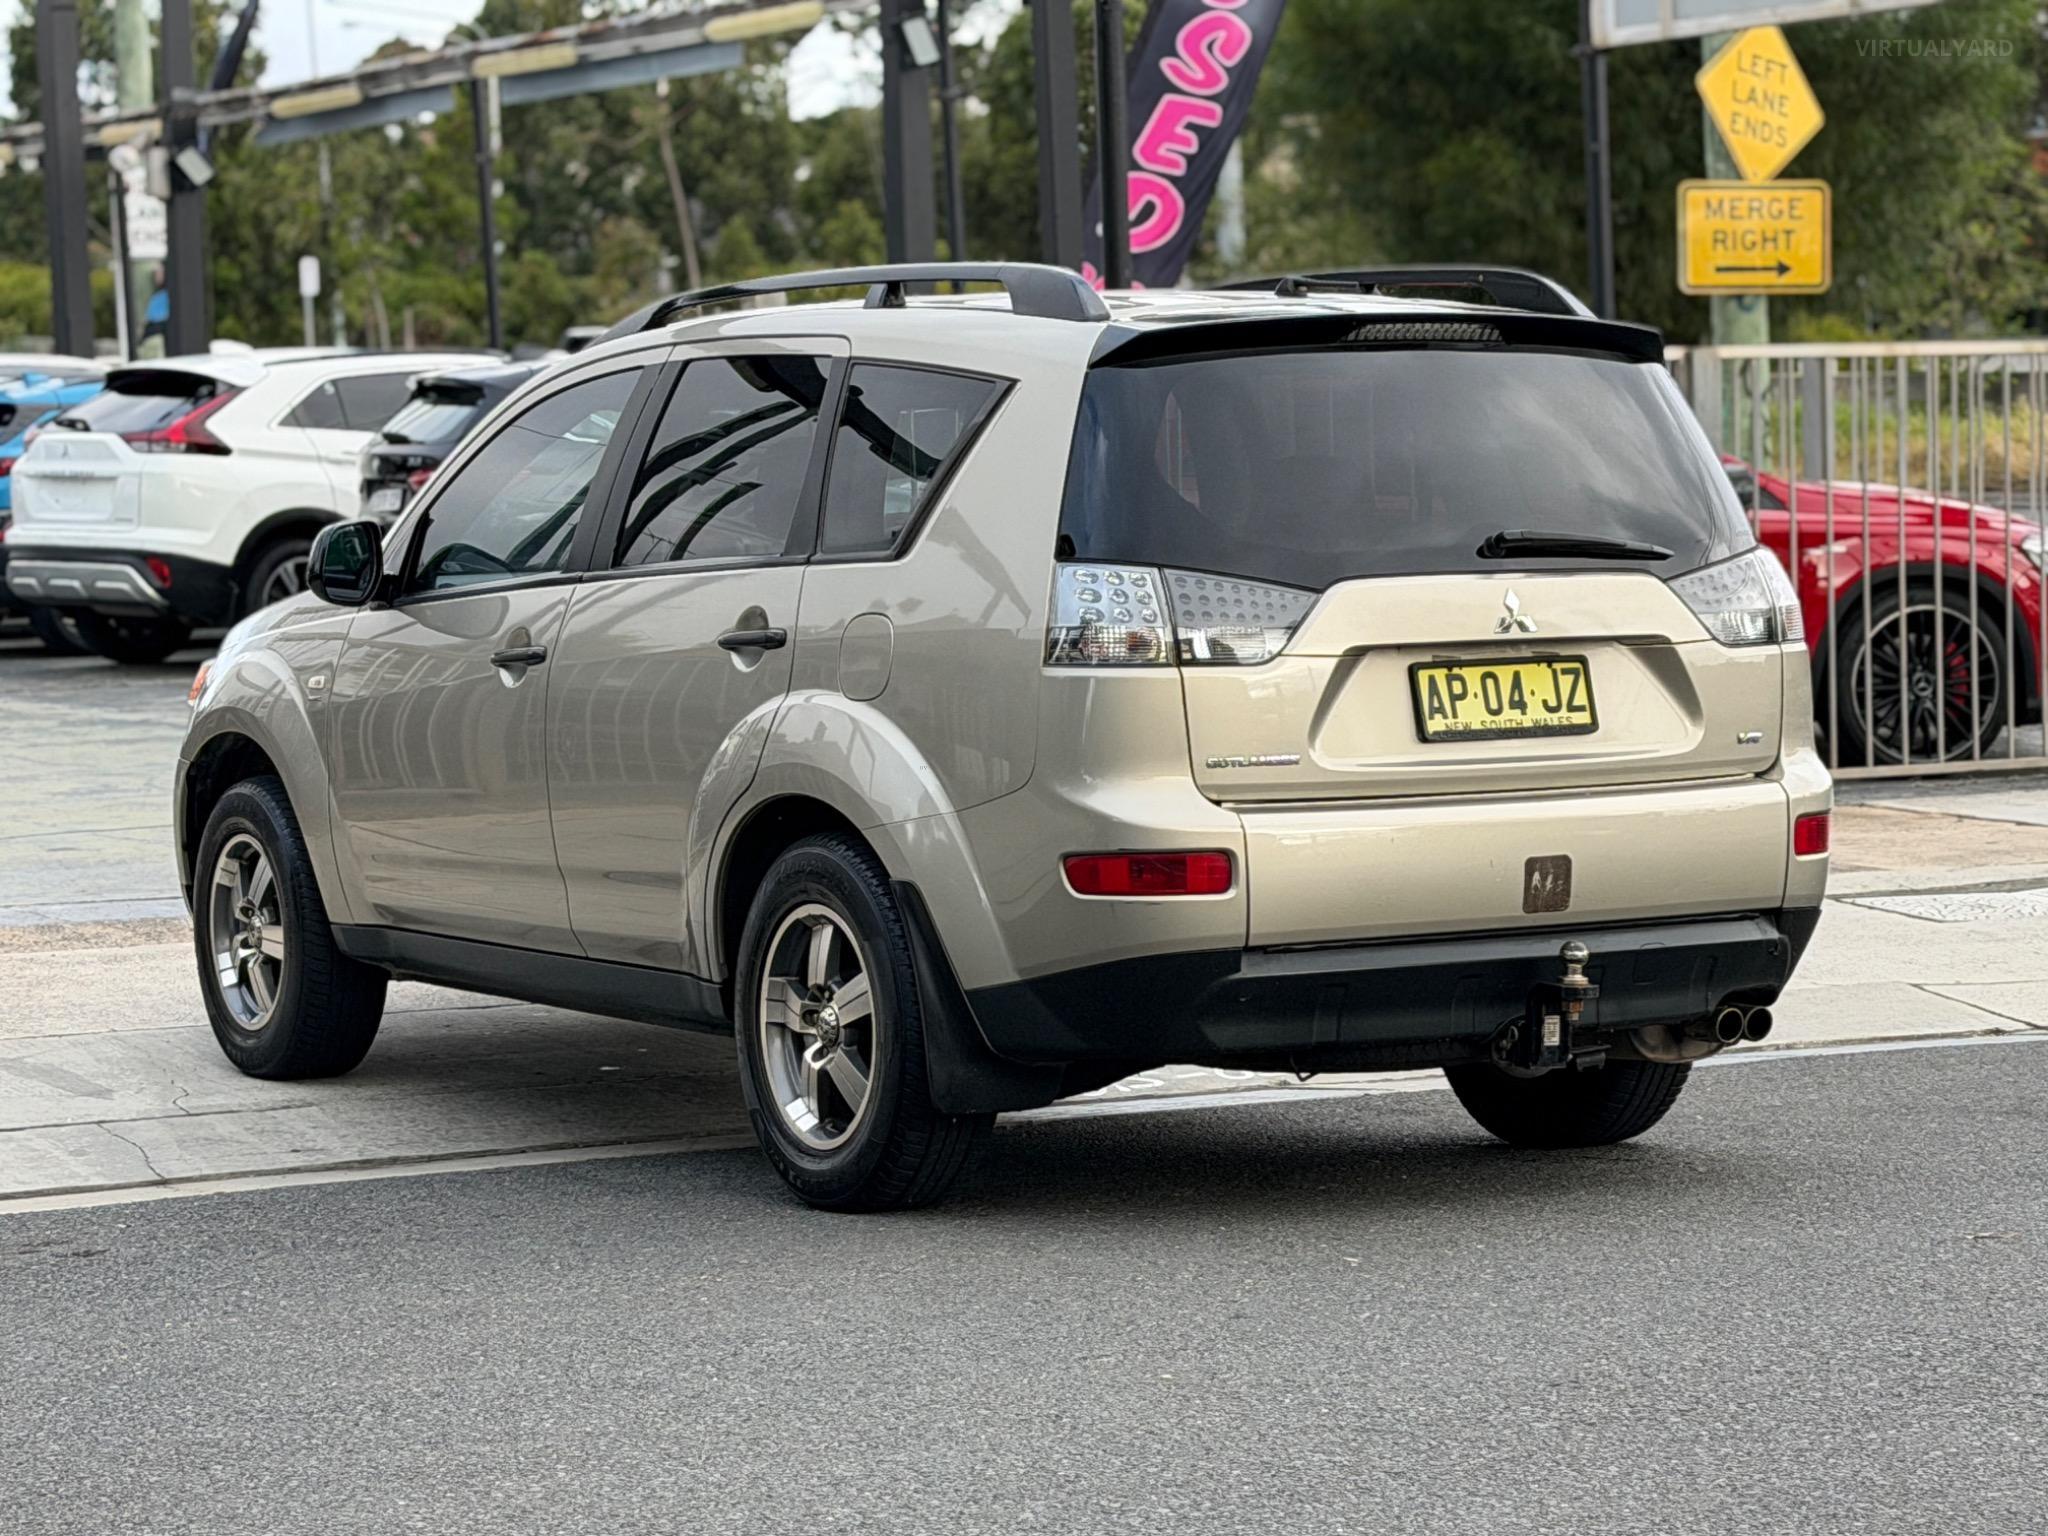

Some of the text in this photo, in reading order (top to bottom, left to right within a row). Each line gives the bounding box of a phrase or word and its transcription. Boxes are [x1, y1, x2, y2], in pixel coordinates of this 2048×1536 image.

[1737, 50, 1788, 84] LEFT
[1731, 80, 1789, 118] LANE
[1127, 0, 1252, 254] SED
[1730, 111, 1788, 149] ENDS
[1705, 197, 1804, 221] MERGE
[1712, 228, 1796, 252] RIGHT
[1444, 716, 1574, 731] NEW SOUTH WALES
